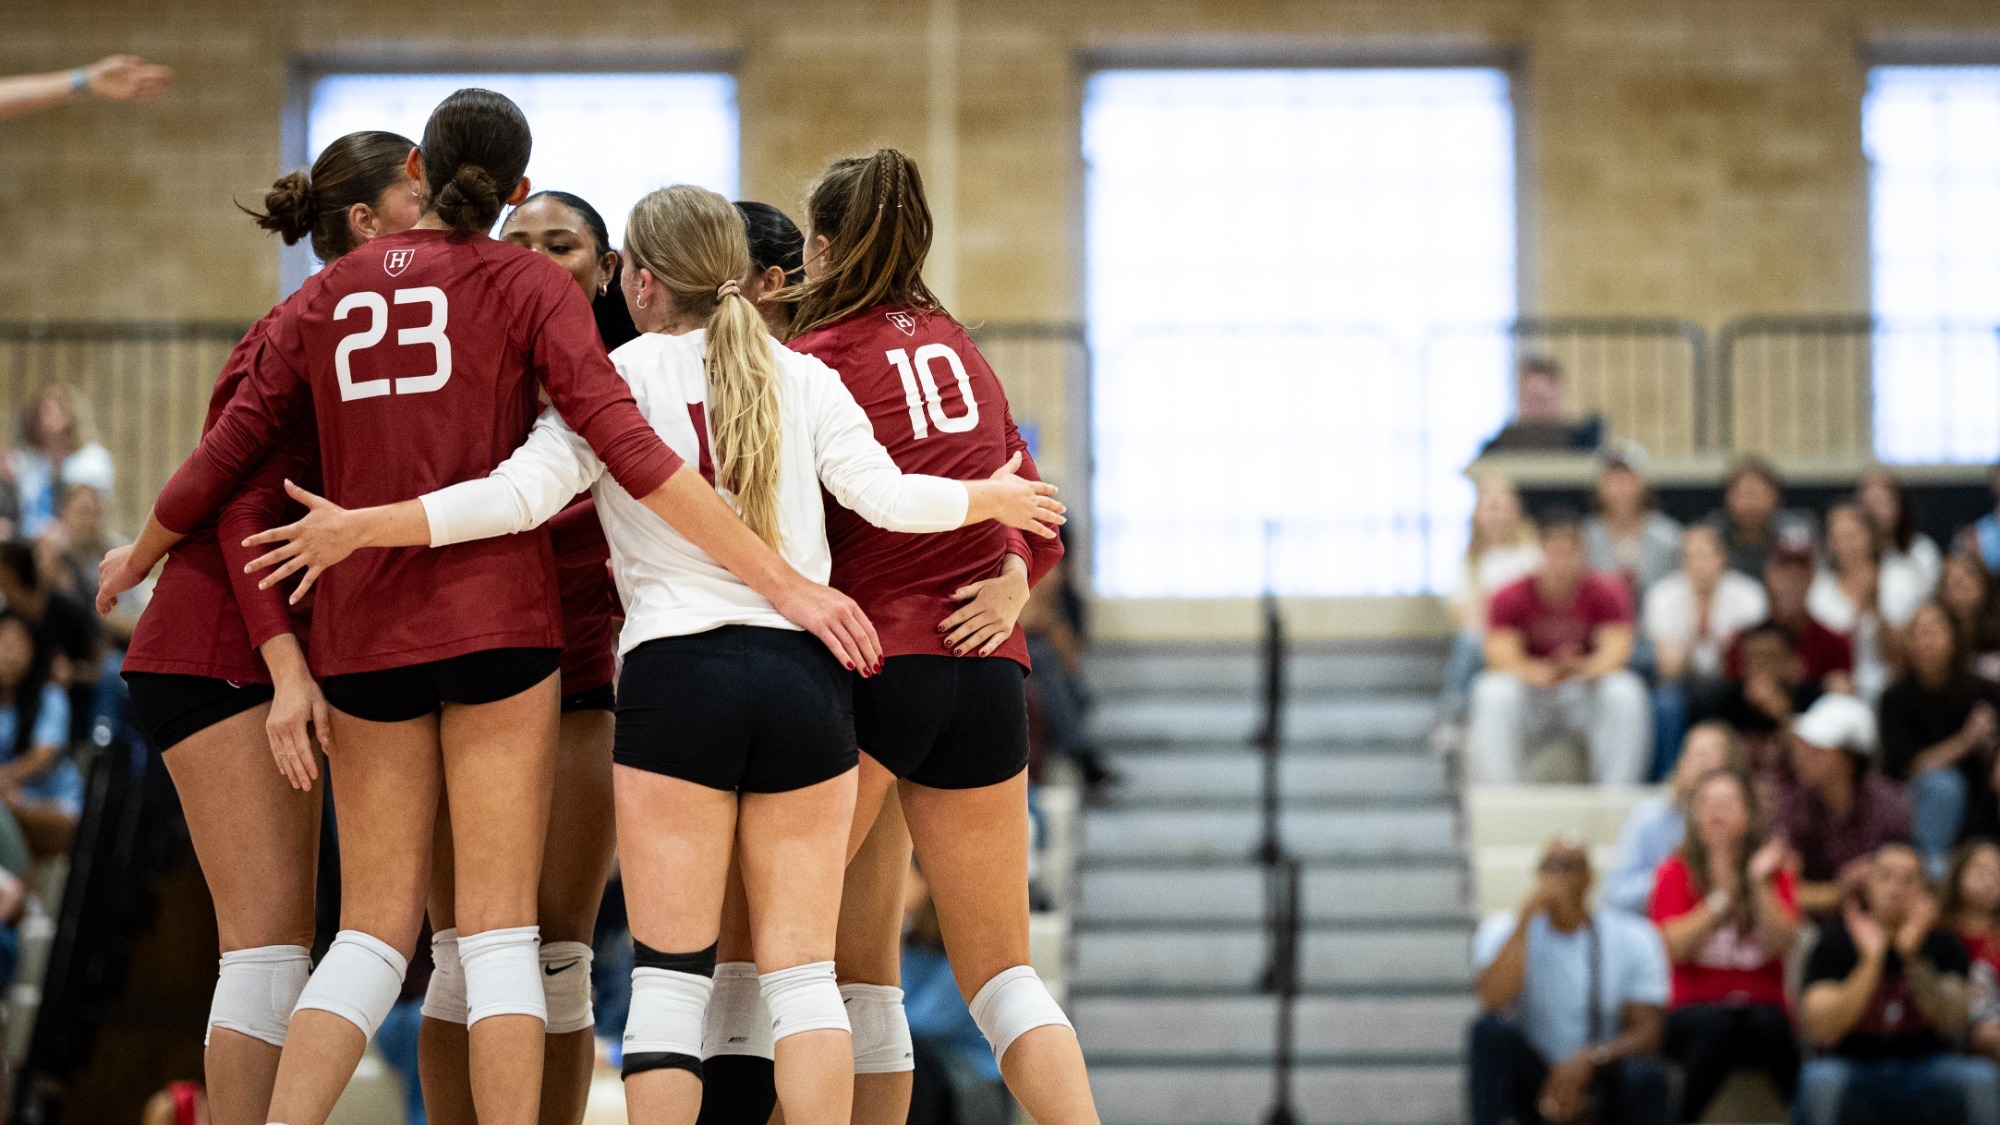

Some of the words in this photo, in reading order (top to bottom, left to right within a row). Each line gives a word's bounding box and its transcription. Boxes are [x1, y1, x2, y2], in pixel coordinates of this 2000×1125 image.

[389, 252, 407, 268] H
[333, 286, 452, 402] 23
[892, 315, 912, 328] H
[885, 343, 979, 440] 10
